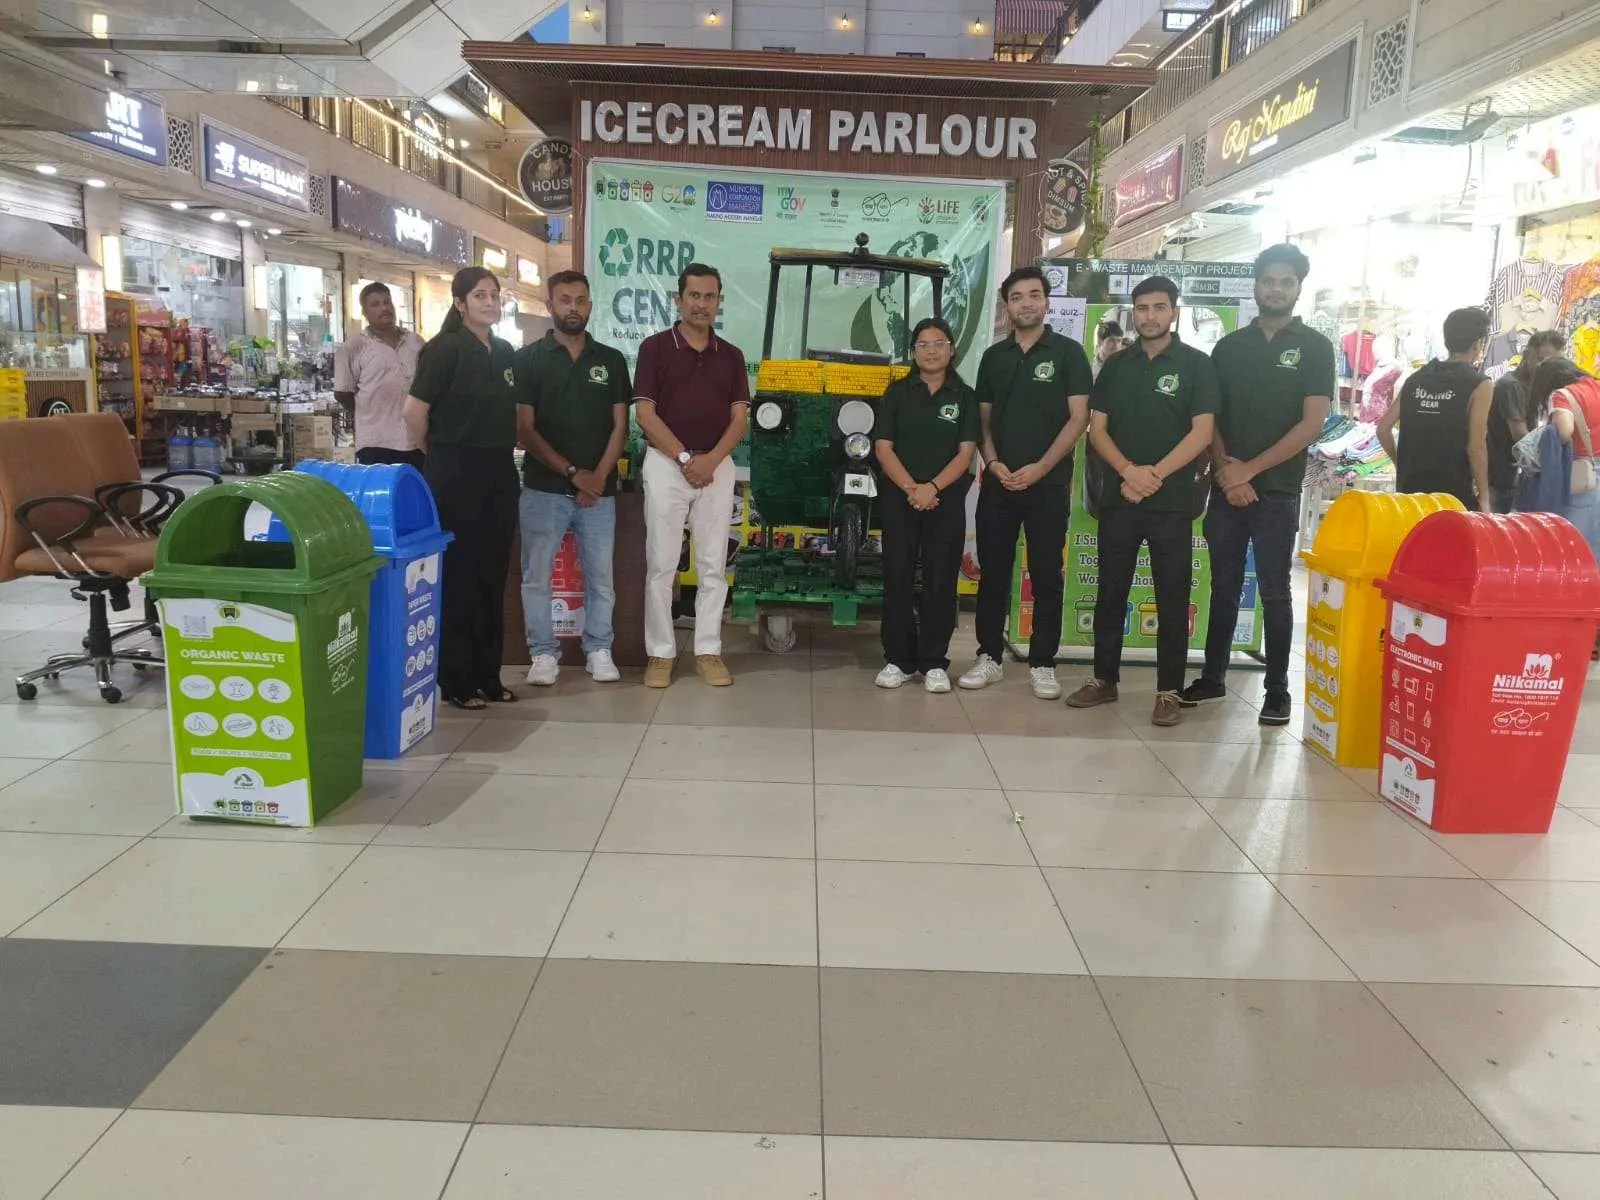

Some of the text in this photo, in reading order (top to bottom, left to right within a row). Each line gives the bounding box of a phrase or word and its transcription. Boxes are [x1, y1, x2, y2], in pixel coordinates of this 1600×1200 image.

[1221, 119, 1253, 164] Raj
[1252, 78, 1320, 141] Nandini
[580, 100, 1037, 160] ICECREAM PARLOUR
[532, 177, 572, 193] HOUS
[778, 187, 794, 200] my
[1048, 190, 1075, 212] DIMSUM
[781, 197, 806, 212] GOV
[1076, 264, 1082, 273] E
[1093, 263, 1128, 273] WASTE
[1131, 263, 1204, 275] MANAGEMENT
[1206, 264, 1254, 275] PROJECT
[1421, 400, 1439, 408] GEAR
[180, 649, 285, 663] ORGANIC WASTE
[1390, 644, 1443, 672] ELECTRONIC WASTE
[1493, 674, 1564, 690] Nilkamal
